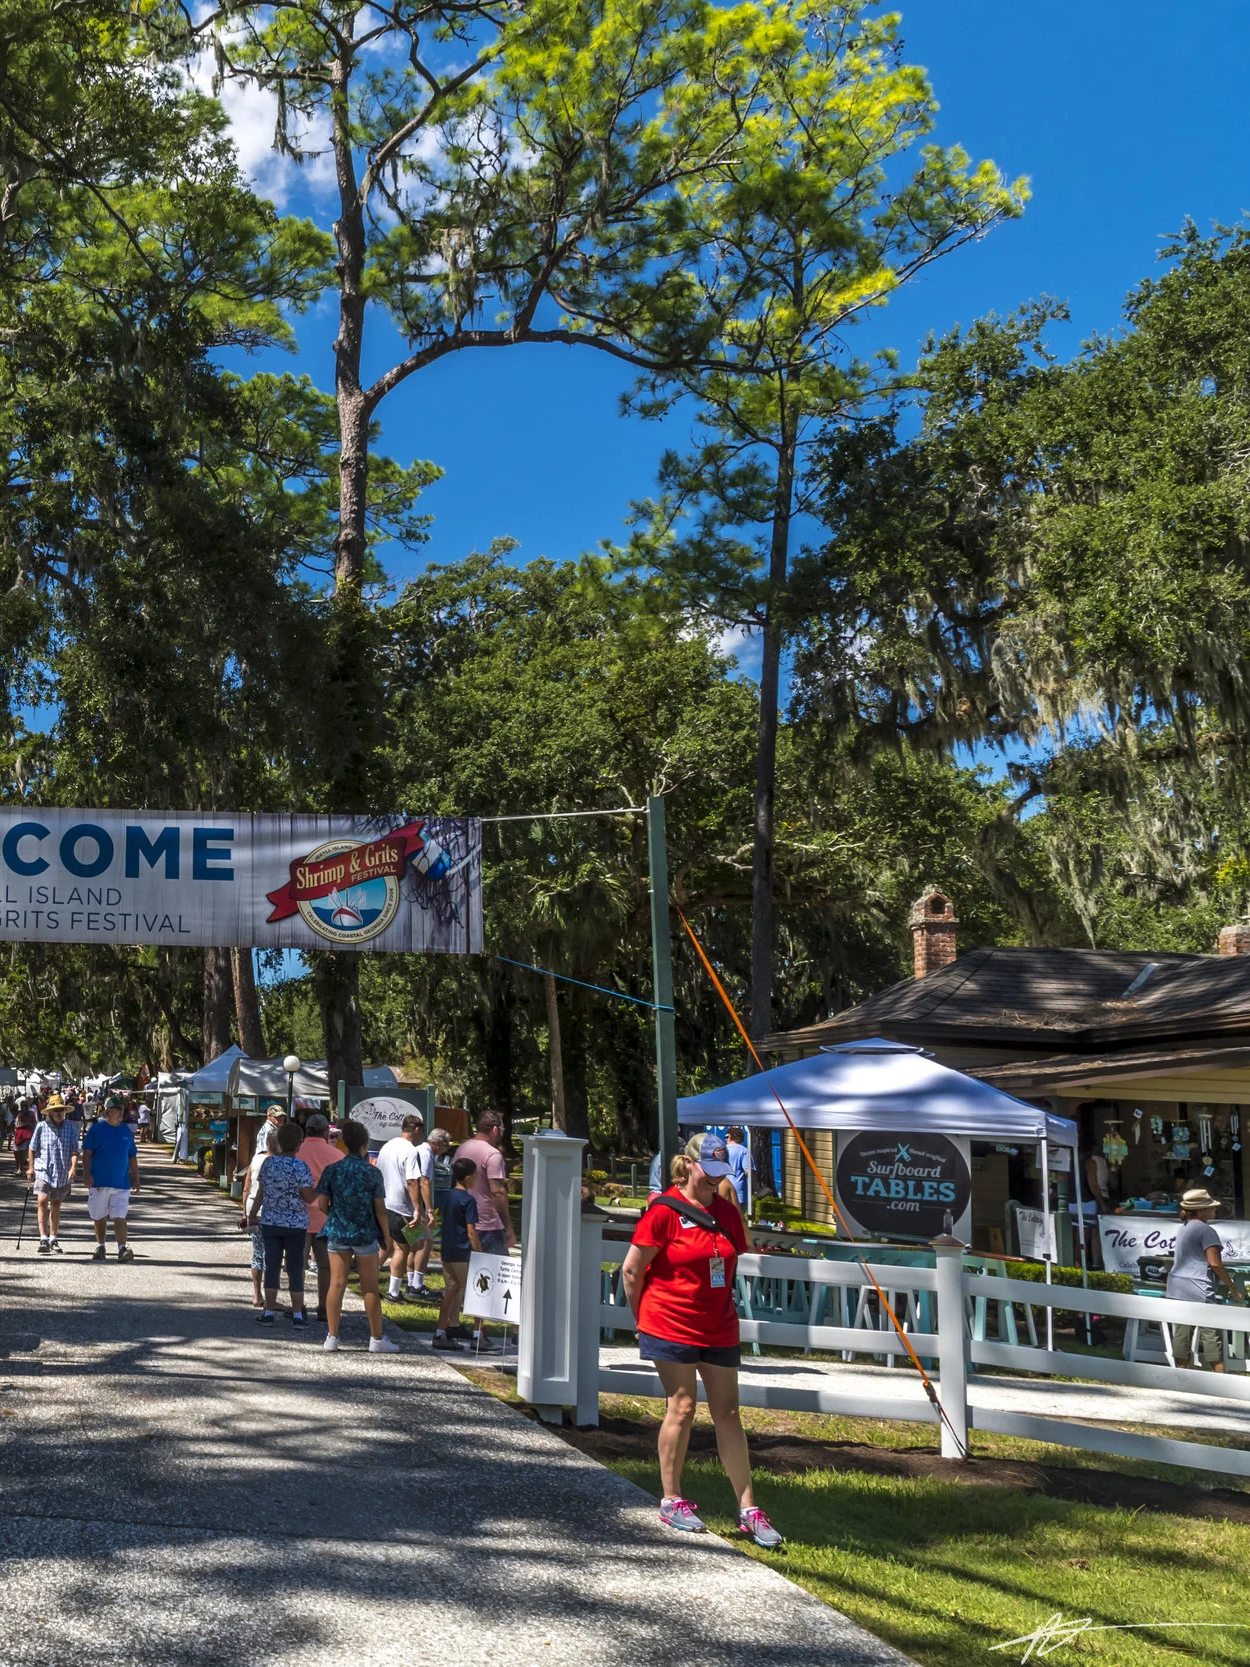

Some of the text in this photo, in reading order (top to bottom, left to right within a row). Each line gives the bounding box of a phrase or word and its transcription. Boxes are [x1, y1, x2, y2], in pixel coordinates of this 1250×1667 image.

[296, 843, 399, 889] Shrimp & Grits
[351, 866, 397, 883] FESTIVAL
[28, 886, 122, 906] ISLAND
[70, 911, 191, 933] FESTIVAL
[306, 911, 338, 938] CELEBRATING
[364, 918, 385, 935] GEORGIA
[383, 902, 393, 919] SINCE
[372, 1111, 405, 1121] The Cott
[867, 1160, 941, 1178] Surfboard
[850, 1176, 956, 1202] TABLES
[886, 1201, 920, 1212] .com
[1104, 1229, 1177, 1249] The Cot
